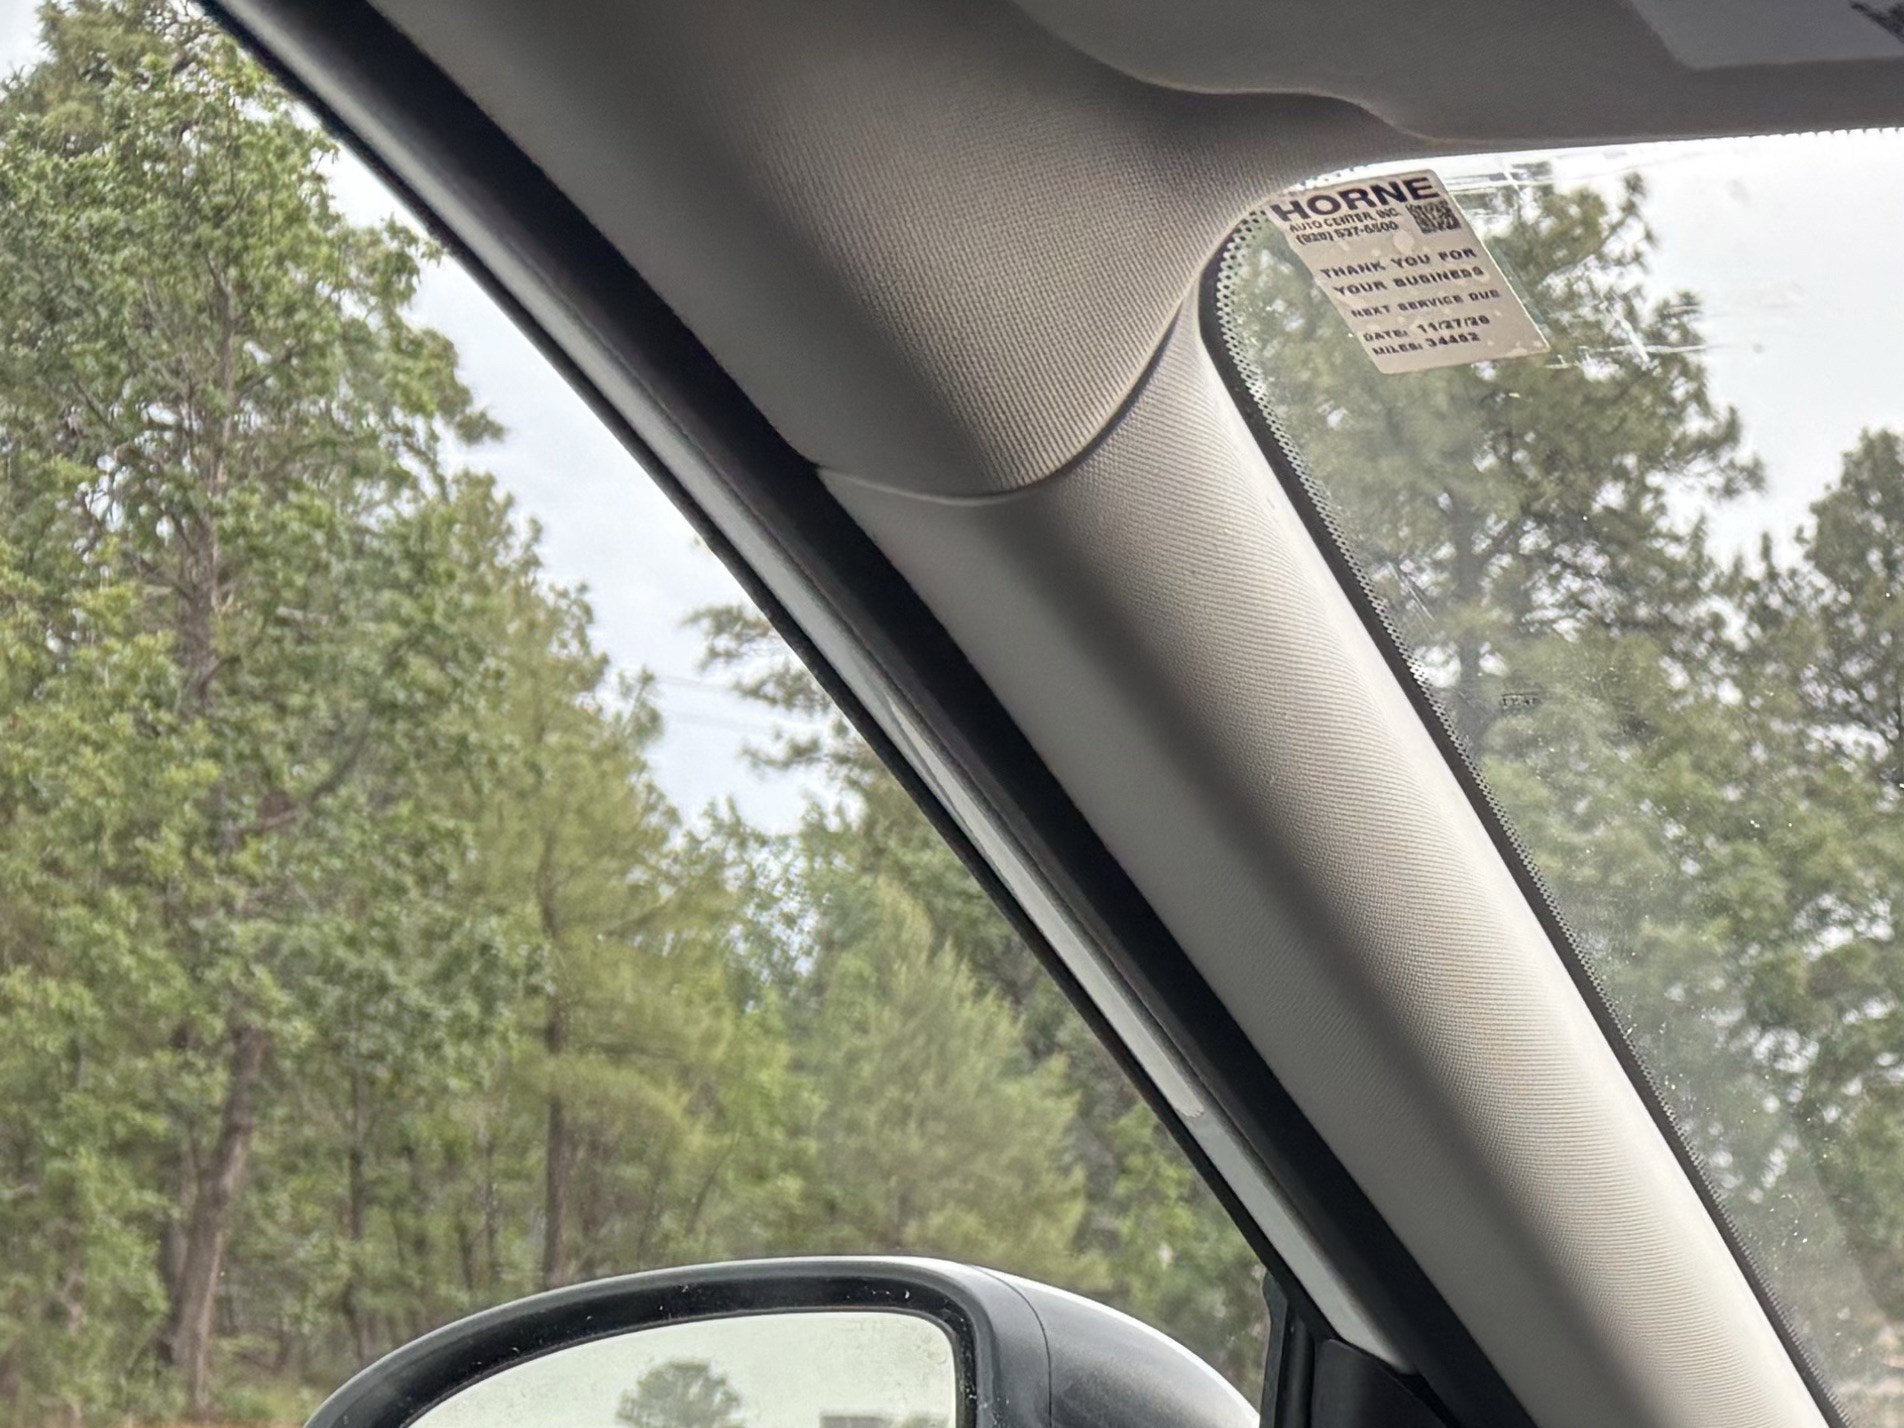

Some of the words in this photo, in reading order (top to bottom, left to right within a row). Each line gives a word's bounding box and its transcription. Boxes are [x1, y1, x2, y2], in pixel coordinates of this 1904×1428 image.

[1270, 176, 1440, 222] HORNE
[1320, 260, 1386, 279] THANK
[1390, 254, 1431, 269] YOU
[1438, 247, 1478, 262] FOR
[1333, 280, 1388, 296] YOUR
[1351, 304, 1391, 318] NEXT
[1468, 289, 1501, 301] DUE
